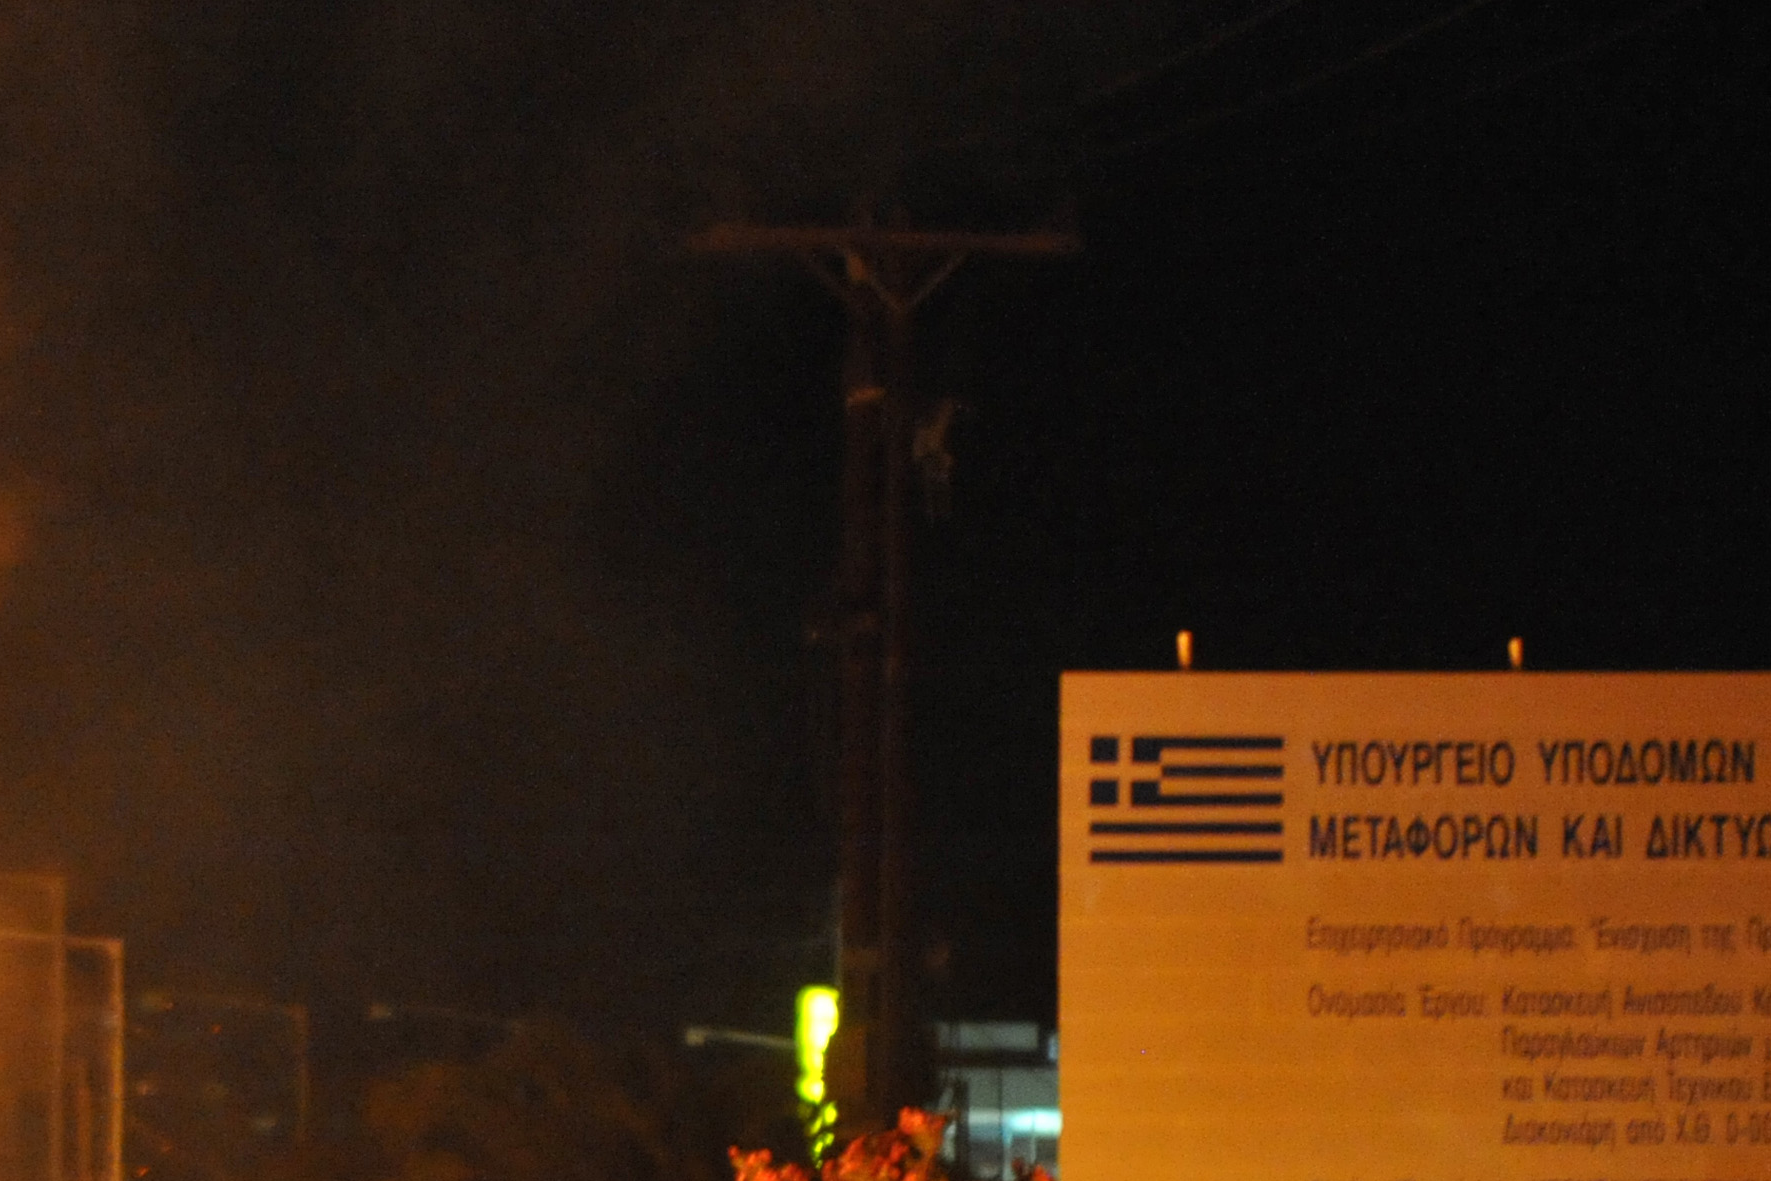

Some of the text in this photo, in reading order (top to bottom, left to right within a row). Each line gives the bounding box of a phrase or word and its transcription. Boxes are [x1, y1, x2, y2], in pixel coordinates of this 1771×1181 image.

[1311, 738, 1755, 786] ΥΠΟΥΡΓΕΙΟ ΥΠΟΔΟΜΩΝ
[1309, 814, 1538, 860] ΜΕΤΑΦΟΡΩΝ
[1562, 813, 1623, 859] ΚΑΙ
